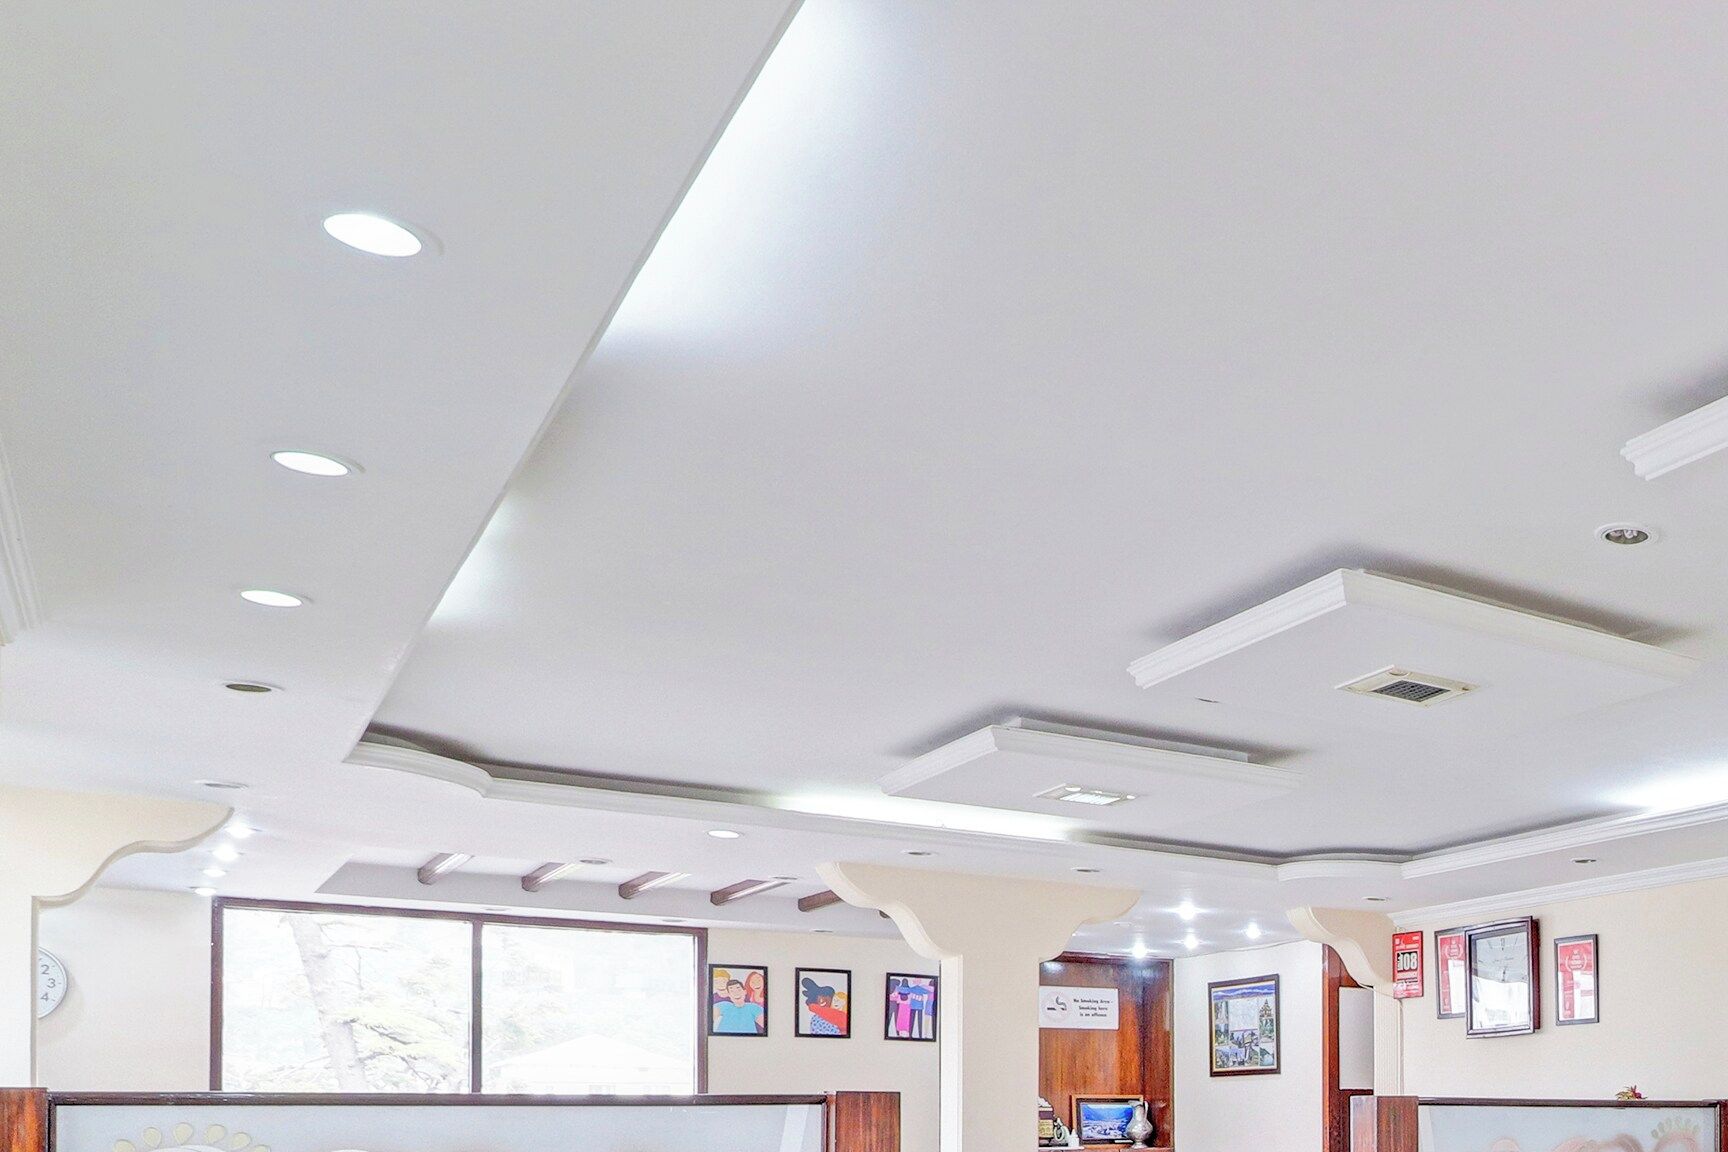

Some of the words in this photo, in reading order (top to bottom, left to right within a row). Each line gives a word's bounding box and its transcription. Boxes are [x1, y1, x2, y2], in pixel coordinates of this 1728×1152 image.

[1398, 952, 1418, 971] 108
[40, 964, 50, 975] 2
[46, 978, 56, 989] 3
[40, 992, 50, 1002] 4
